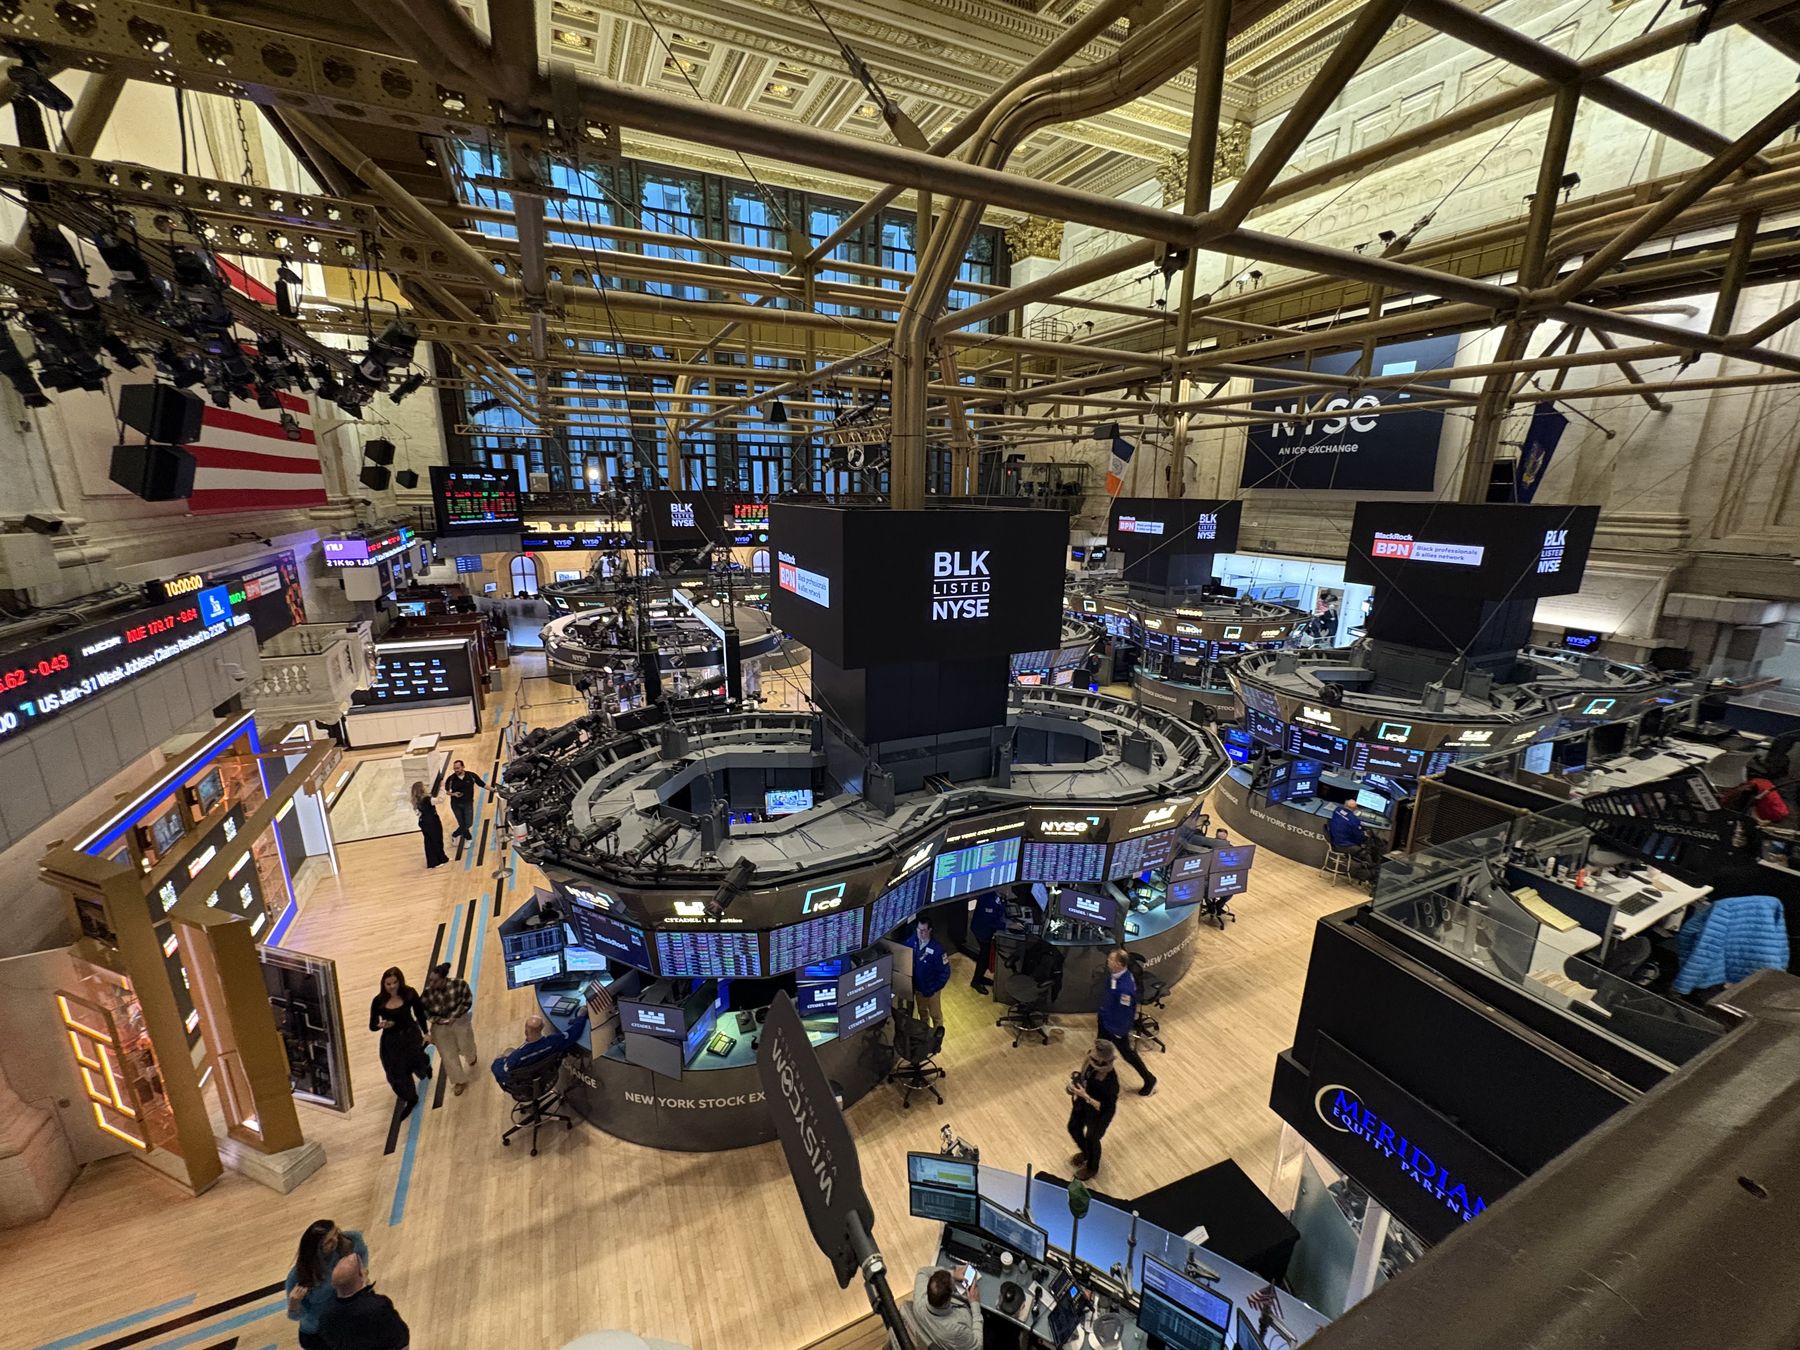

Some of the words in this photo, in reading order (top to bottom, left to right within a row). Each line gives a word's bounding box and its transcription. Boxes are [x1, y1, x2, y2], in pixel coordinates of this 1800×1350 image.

[671, 504, 693, 512] BLK
[1200, 514, 1217, 523] BLK
[1197, 531, 1216, 539] NYSE
[1375, 532, 1413, 540] BlackRock
[1544, 530, 1568, 546] BLK
[1376, 543, 1409, 555] BPN
[934, 550, 990, 577] BLK
[1537, 560, 1561, 574] NYSE
[164, 574, 203, 597] 10:00:00
[780, 567, 796, 588] BPN
[933, 581, 990, 595] LISTED
[932, 599, 990, 620] NYSE
[148, 616, 175, 635] 179.17
[1566, 635, 1591, 645] NYSE
[38, 694, 60, 713] US
[60, 677, 98, 705] Jan-31
[96, 666, 125, 687] Week
[123, 653, 156, 676] Jobless
[154, 643, 180, 662] Claims
[178, 630, 204, 651] Revised
[1041, 821, 1088, 832] NYSE
[1250, 807, 1265, 820] NEW
[1266, 815, 1286, 829] YORK
[1286, 824, 1315, 839] STOCK
[813, 897, 842, 912] ICE
[1143, 955, 1163, 969] NEW
[1163, 946, 1180, 960] YORK
[625, 1091, 654, 1105] NEW
[658, 1097, 696, 1109] YORK
[699, 1095, 746, 1109] STOCK
[772, 1037, 833, 1207] WISYCOM
[1333, 1107, 1393, 1158] EQUITY
